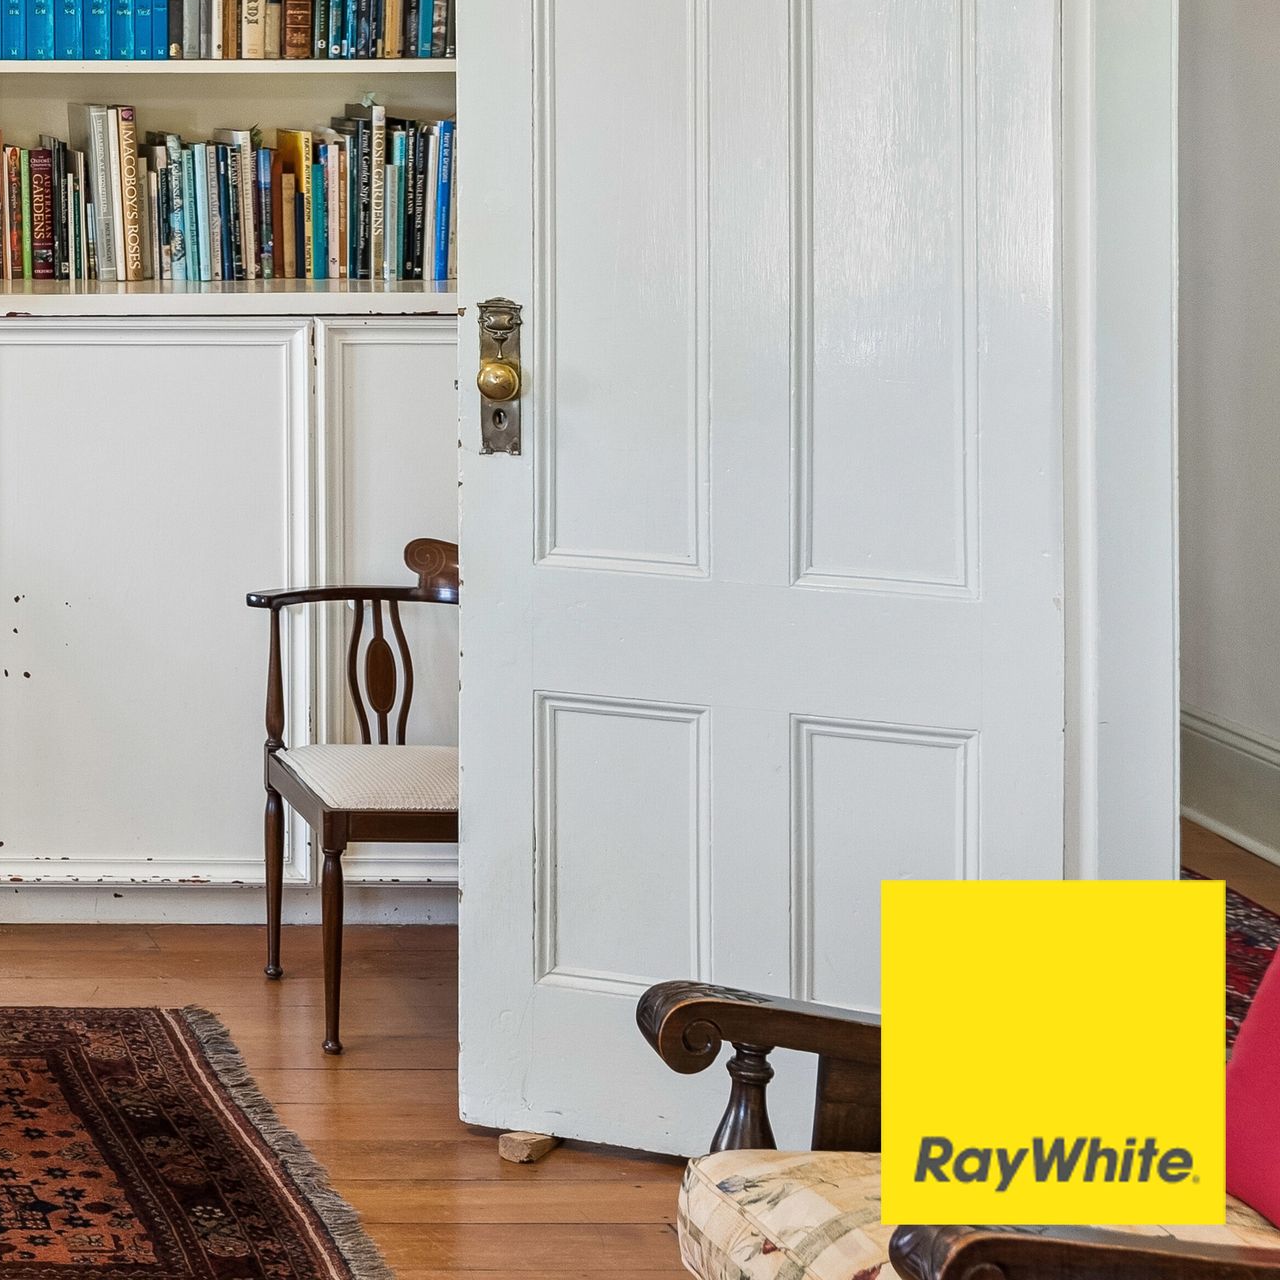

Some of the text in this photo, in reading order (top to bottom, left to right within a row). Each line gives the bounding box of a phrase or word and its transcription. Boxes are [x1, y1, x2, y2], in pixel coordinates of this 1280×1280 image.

[362, 129, 370, 153] French
[32, 173, 44, 239] GARDENS
[44, 174, 52, 239] AUSTRALIAN
[122, 130, 141, 269] MACOBOY'S ROSES
[360, 185, 369, 204] Style
[373, 129, 384, 235] ROSE GARDENS
[416, 174, 424, 206] ENGLISH
